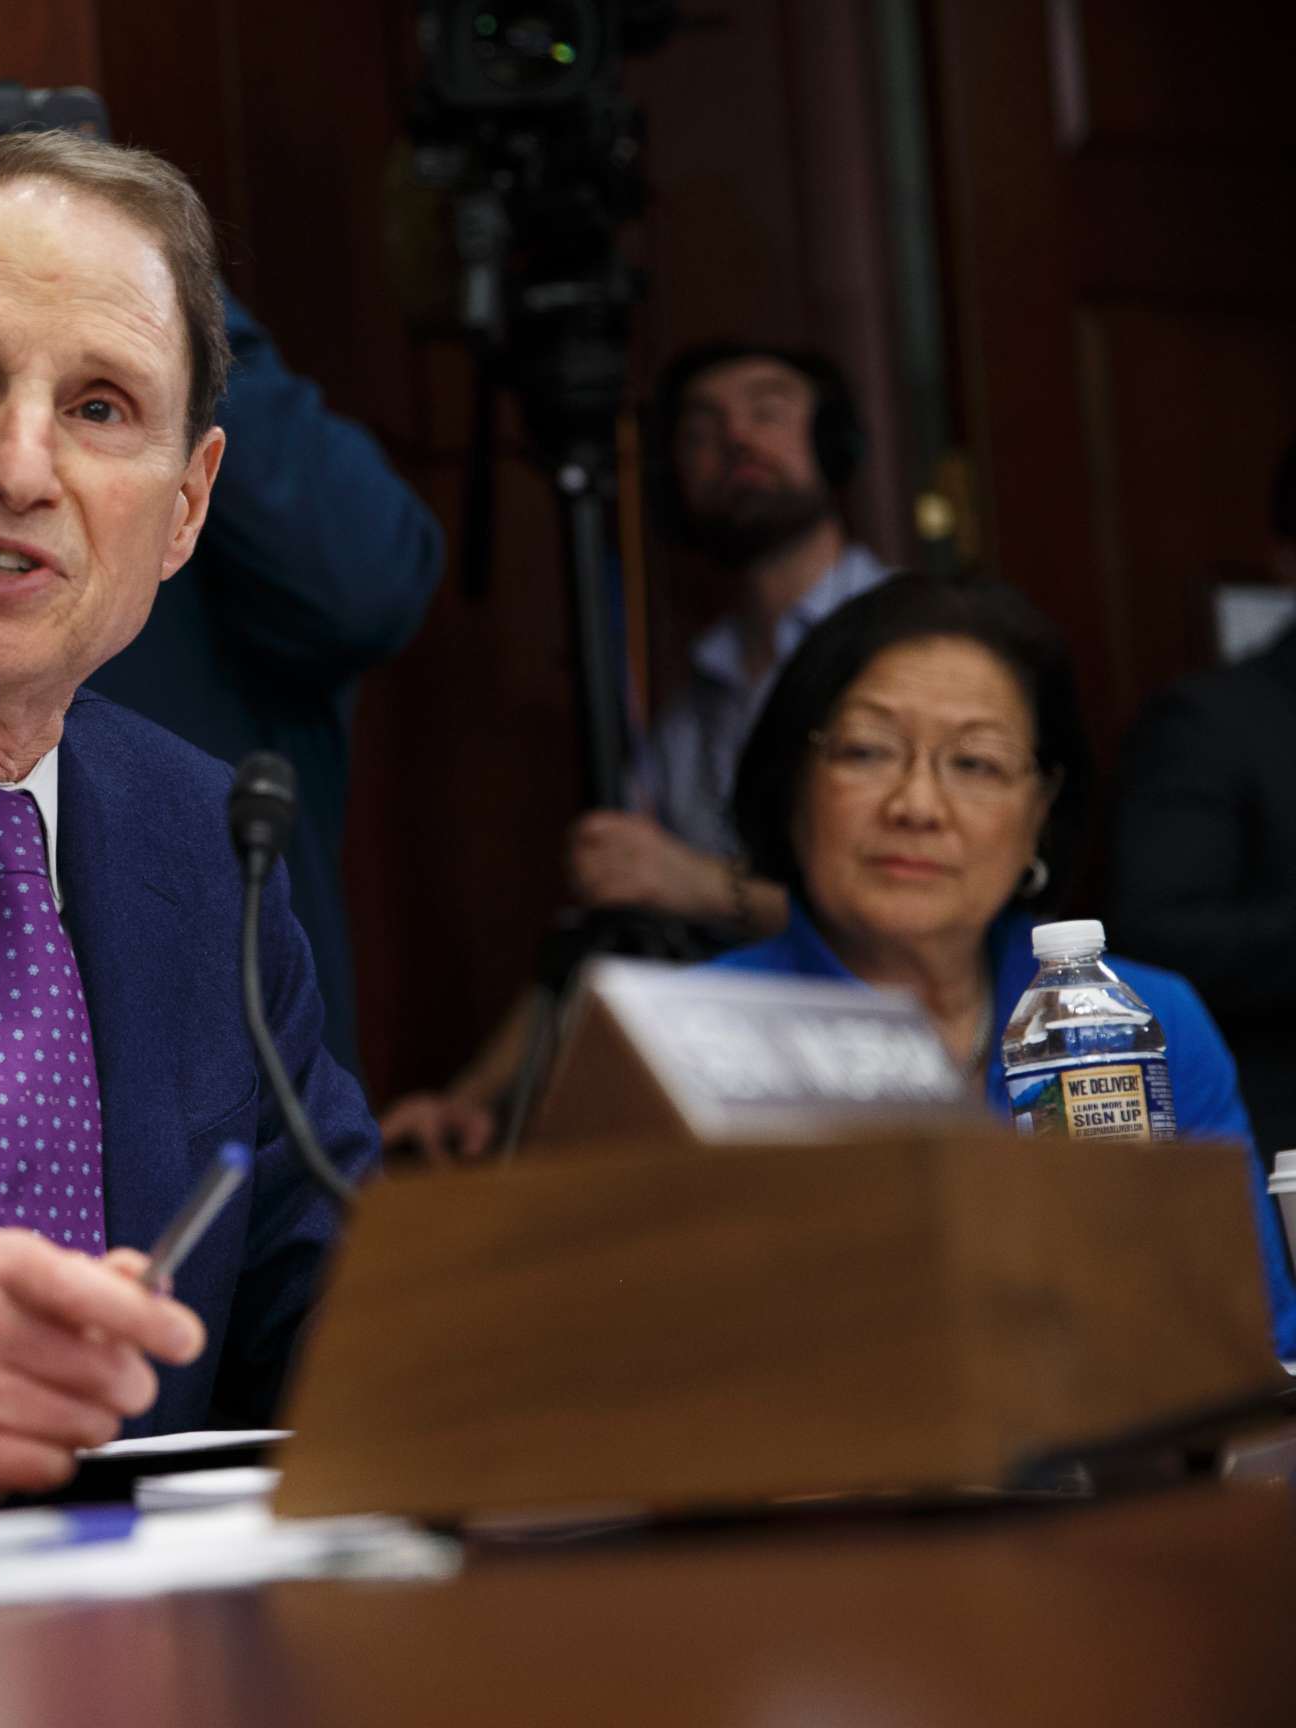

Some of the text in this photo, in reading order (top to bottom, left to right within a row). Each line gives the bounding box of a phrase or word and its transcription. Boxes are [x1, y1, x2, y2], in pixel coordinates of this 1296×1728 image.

[1068, 1075, 1140, 1097] WE DELIVER!
[1072, 1103, 1099, 1113] LEARN
[1101, 1101, 1122, 1110] MORE
[1074, 1109, 1141, 1127] SIGN UP
